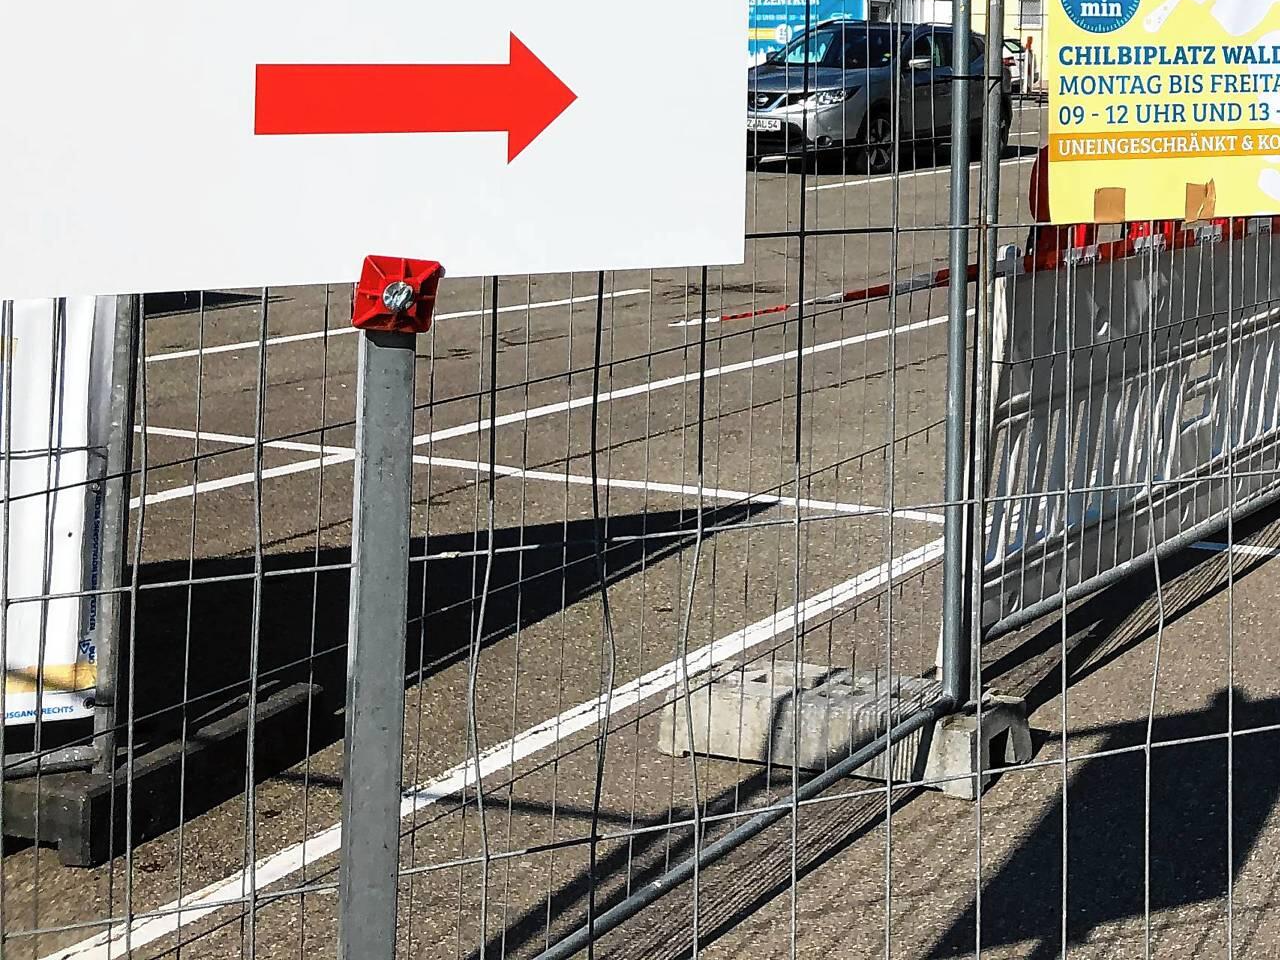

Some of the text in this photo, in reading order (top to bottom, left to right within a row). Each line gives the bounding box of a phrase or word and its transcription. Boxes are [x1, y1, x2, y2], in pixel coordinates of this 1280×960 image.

[1058, 45, 1216, 66] CHILBIPLATZ
[1059, 74, 1162, 96] MONTAG
[1169, 74, 1204, 94] BIS
[1059, 105, 1085, 126] 09
[1105, 104, 1129, 124] 12
[1135, 103, 1186, 124] UHR
[1192, 102, 1242, 123] UND
[1248, 102, 1270, 121] 13
[1058, 133, 1237, 156] UNEINGESCHRÄNKT
[1241, 135, 1253, 151] &
